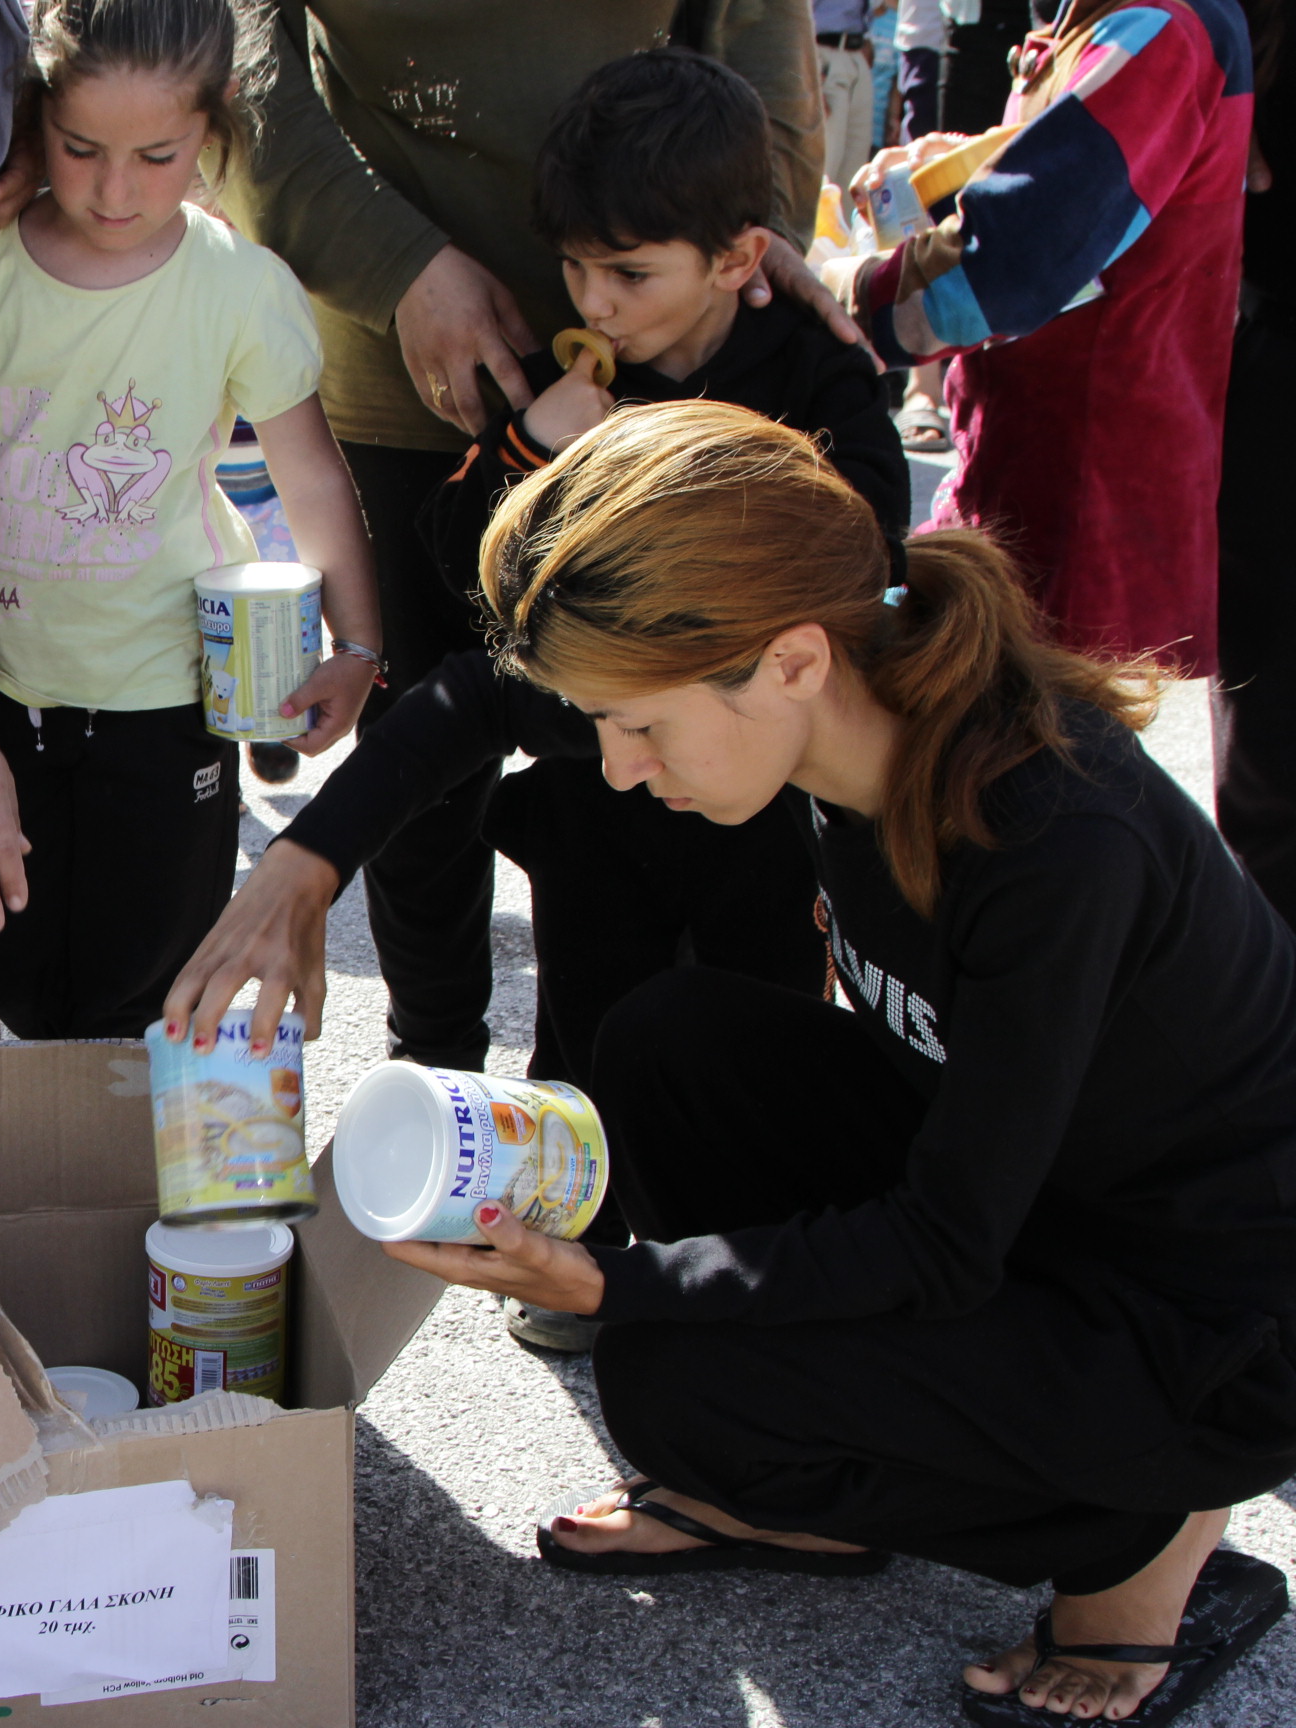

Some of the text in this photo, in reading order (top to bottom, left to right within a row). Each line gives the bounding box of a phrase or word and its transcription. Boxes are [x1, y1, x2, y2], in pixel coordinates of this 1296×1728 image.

[48, 1596, 100, 1614] ΓΑΛΑ
[105, 1585, 175, 1609] ΣΚΟΝΗ
[38, 1620, 96, 1636] 20 τμχ.
[189, 1671, 205, 1681] Old
[103, 1683, 122, 1693] PCH
